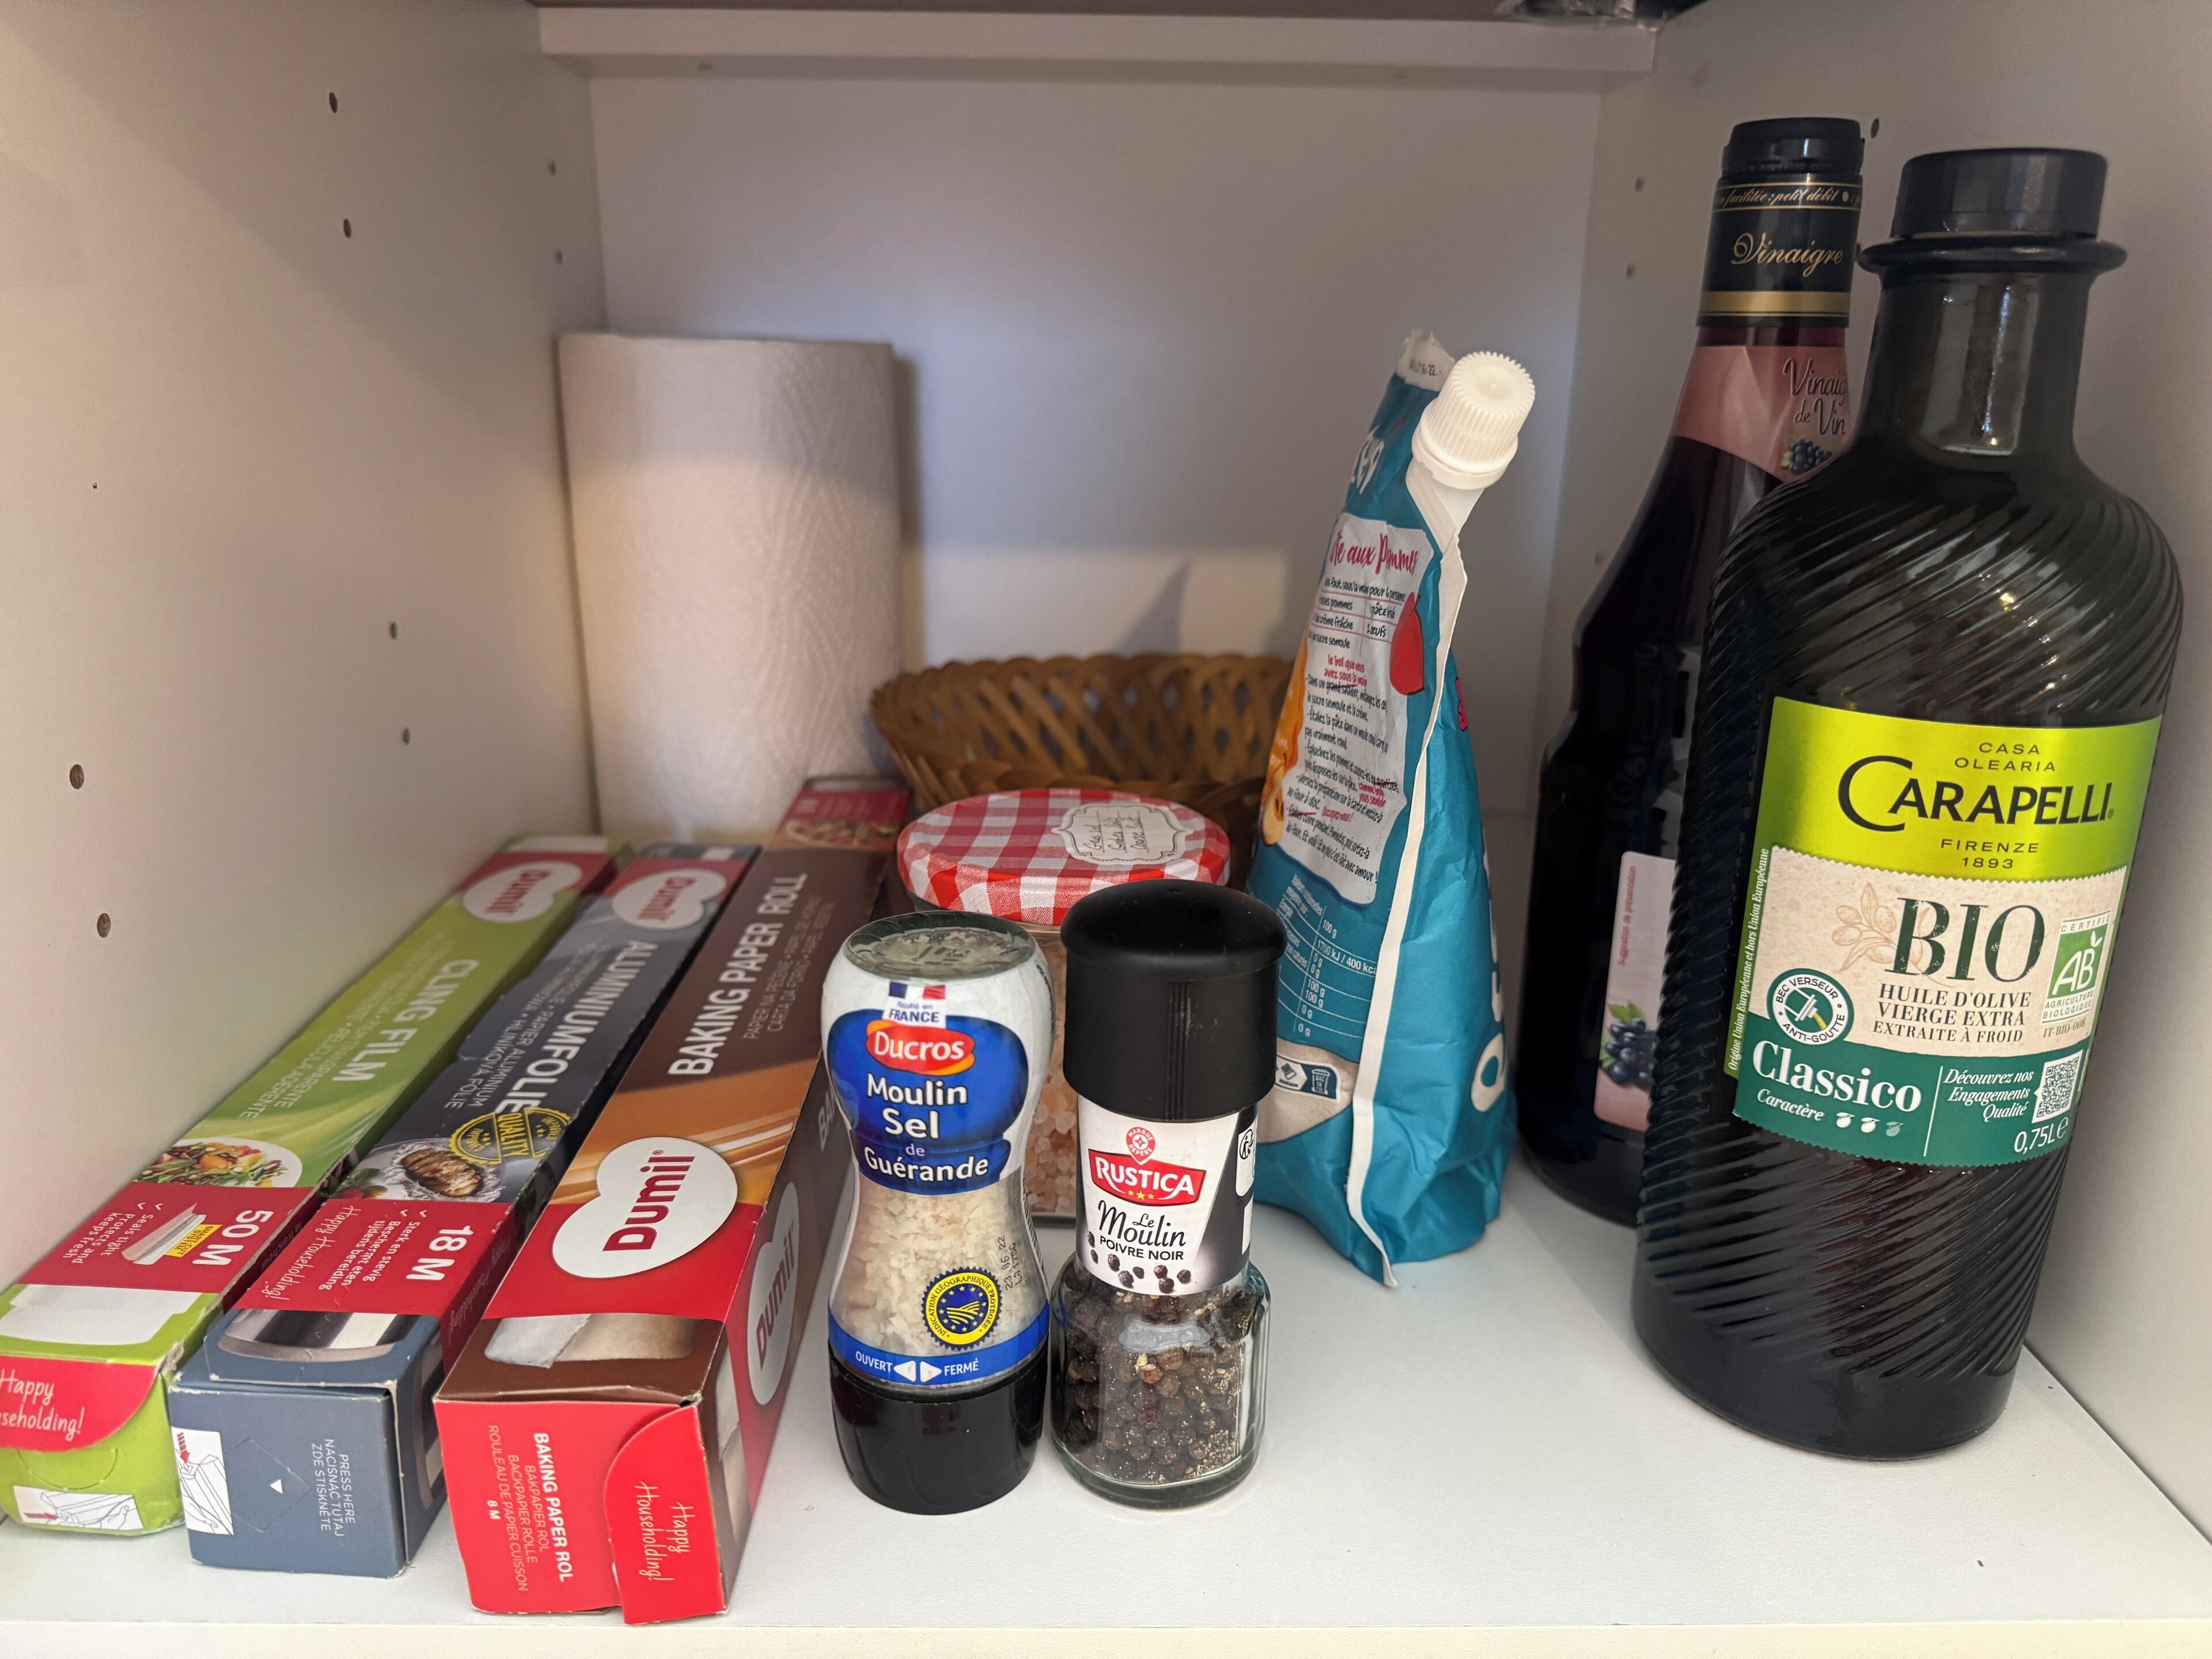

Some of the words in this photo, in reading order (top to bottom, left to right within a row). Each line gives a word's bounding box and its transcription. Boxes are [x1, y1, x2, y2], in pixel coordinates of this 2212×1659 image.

[1806, 187, 1839, 202] débit
[1731, 232, 1842, 278] Vinaigre
[1783, 358, 1846, 406] Vinaig
[1793, 399, 1810, 423] de
[1813, 399, 1845, 435] Vin
[1979, 742, 2040, 755] CASA
[1954, 757, 2056, 771] OLEARIA
[1838, 755, 2112, 832] CARAPELLI
[1941, 839, 2039, 853] FIRENZE
[1752, 848, 1768, 903] Européenne
[1961, 857, 2014, 869] 1893
[1323, 919, 1332, 934] 100
[1331, 929, 1337, 939] g
[1748, 902, 1760, 930] Union
[1745, 931, 1756, 952] hors
[1884, 897, 2045, 982] BIO
[1331, 949, 1340, 961] kJ
[1346, 957, 1361, 970] 400
[1363, 961, 1377, 975] kca
[1745, 950, 1753, 961] et
[666, 987, 751, 1075] BAKING
[718, 922, 783, 983] PAPER
[757, 872, 808, 915] ROLL
[2052, 948, 2095, 995] AB
[393, 959, 480, 1023] CLING
[1305, 990, 1317, 1003] 100
[1308, 979, 1320, 993] 100
[1736, 961, 1752, 1012] Européenne
[1775, 984, 1790, 1003] BEC
[1789, 977, 1839, 1000] VERSEUR
[1878, 983, 1948, 1006] HUILE
[1953, 991, 2031, 1008] D'OLIVE
[2045, 990, 2094, 1009] AGRICULTURE
[889, 1009, 940, 1022] FRANCE
[1877, 1001, 1957, 1025] VIERGE
[1962, 1010, 2025, 1027] EXTRA
[2043, 999, 2092, 1019] BIOLOGIQUE
[1732, 1011, 1744, 1037] Union
[1782, 1013, 1844, 1043] ANTI-GOUTTE
[1873, 1021, 1957, 1041] EXTRAITE
[1961, 1027, 1971, 1043] À
[1976, 1030, 2023, 1043] FROID
[332, 1028, 418, 1082] FILM
[874, 1031, 965, 1060] Ducros
[1728, 1039, 1742, 1070] Origine
[867, 1073, 968, 1106] Moulin
[1753, 1040, 1922, 1112] Classico
[1942, 1069, 2014, 1085] Découvrez
[2015, 1071, 2034, 1082] nos
[1757, 1088, 1825, 1121] Caractère
[1947, 1087, 2031, 1106] Engagements
[881, 1107, 940, 1139] Sel
[1983, 1101, 2029, 1122] Qualité
[497, 1112, 529, 1157] QUALITY
[1128, 1128, 1154, 1141] MARQUE
[2014, 1123, 2055, 1154] 0,75L
[863, 1146, 990, 1182] Guérande
[906, 1143, 926, 1157] de
[1095, 1156, 1195, 1200] RUSTICA
[603, 1156, 695, 1252] Dumil
[89, 1213, 123, 1236] keeps
[96, 1213, 136, 1247] Protects
[124, 1214, 154, 1236] Seals
[221, 1210, 274, 1238] 50
[315, 1206, 362, 1234] Happy
[355, 1220, 386, 1248] tijdens
[399, 1221, 421, 1243] Sterk
[1097, 1199, 1187, 1247] Moulin
[1132, 1213, 1155, 1228] Le
[62, 1237, 92, 1259] fresh
[101, 1236, 130, 1256] tight
[357, 1221, 402, 1265] Beschermt
[387, 1244, 401, 1254] en
[429, 1225, 474, 1251] 18
[1100, 1234, 1145, 1259] POIVRE
[1148, 1249, 1184, 1261] NOIR
[71, 1248, 94, 1264] and
[192, 1244, 244, 1265] M
[262, 1236, 336, 1300] Householding!
[362, 1255, 392, 1282] stevig
[319, 1249, 365, 1290] bereiding
[406, 1257, 455, 1281] M
[935, 1275, 991, 1294] GÉOGRAPHIQUE
[756, 1227, 794, 1372] Dumil
[929, 1294, 946, 1336] INDICATION
[855, 1350, 893, 1373] OUVERT
[944, 1357, 979, 1377] FERMÉ
[0, 1368, 55, 1406] Happy
[0, 1404, 85, 1441] seholding!
[312, 1443, 324, 1467] ZDE
[488, 1425, 508, 1483] ROULEAU
[533, 1433, 559, 1493] BAKING
[339, 1454, 352, 1491] PRESS
[498, 1483, 512, 1499] DE
[331, 1502, 344, 1536] TUTAJ
[343, 1494, 356, 1524] HERE
[489, 1510, 501, 1521] M
[502, 1501, 519, 1541] PAPIER
[507, 1454, 531, 1526] BACKPAPIER
[522, 1527, 539, 1564] ROLLE
[524, 1465, 547, 1529] BAKPAPIER
[537, 1529, 550, 1553] ROL
[546, 1497, 568, 1548] PAPER
[634, 1481, 675, 1581] Householding!
[665, 1501, 696, 1554] Happy
[509, 1542, 529, 1592] CUISSON
[555, 1551, 574, 1583] ROL
